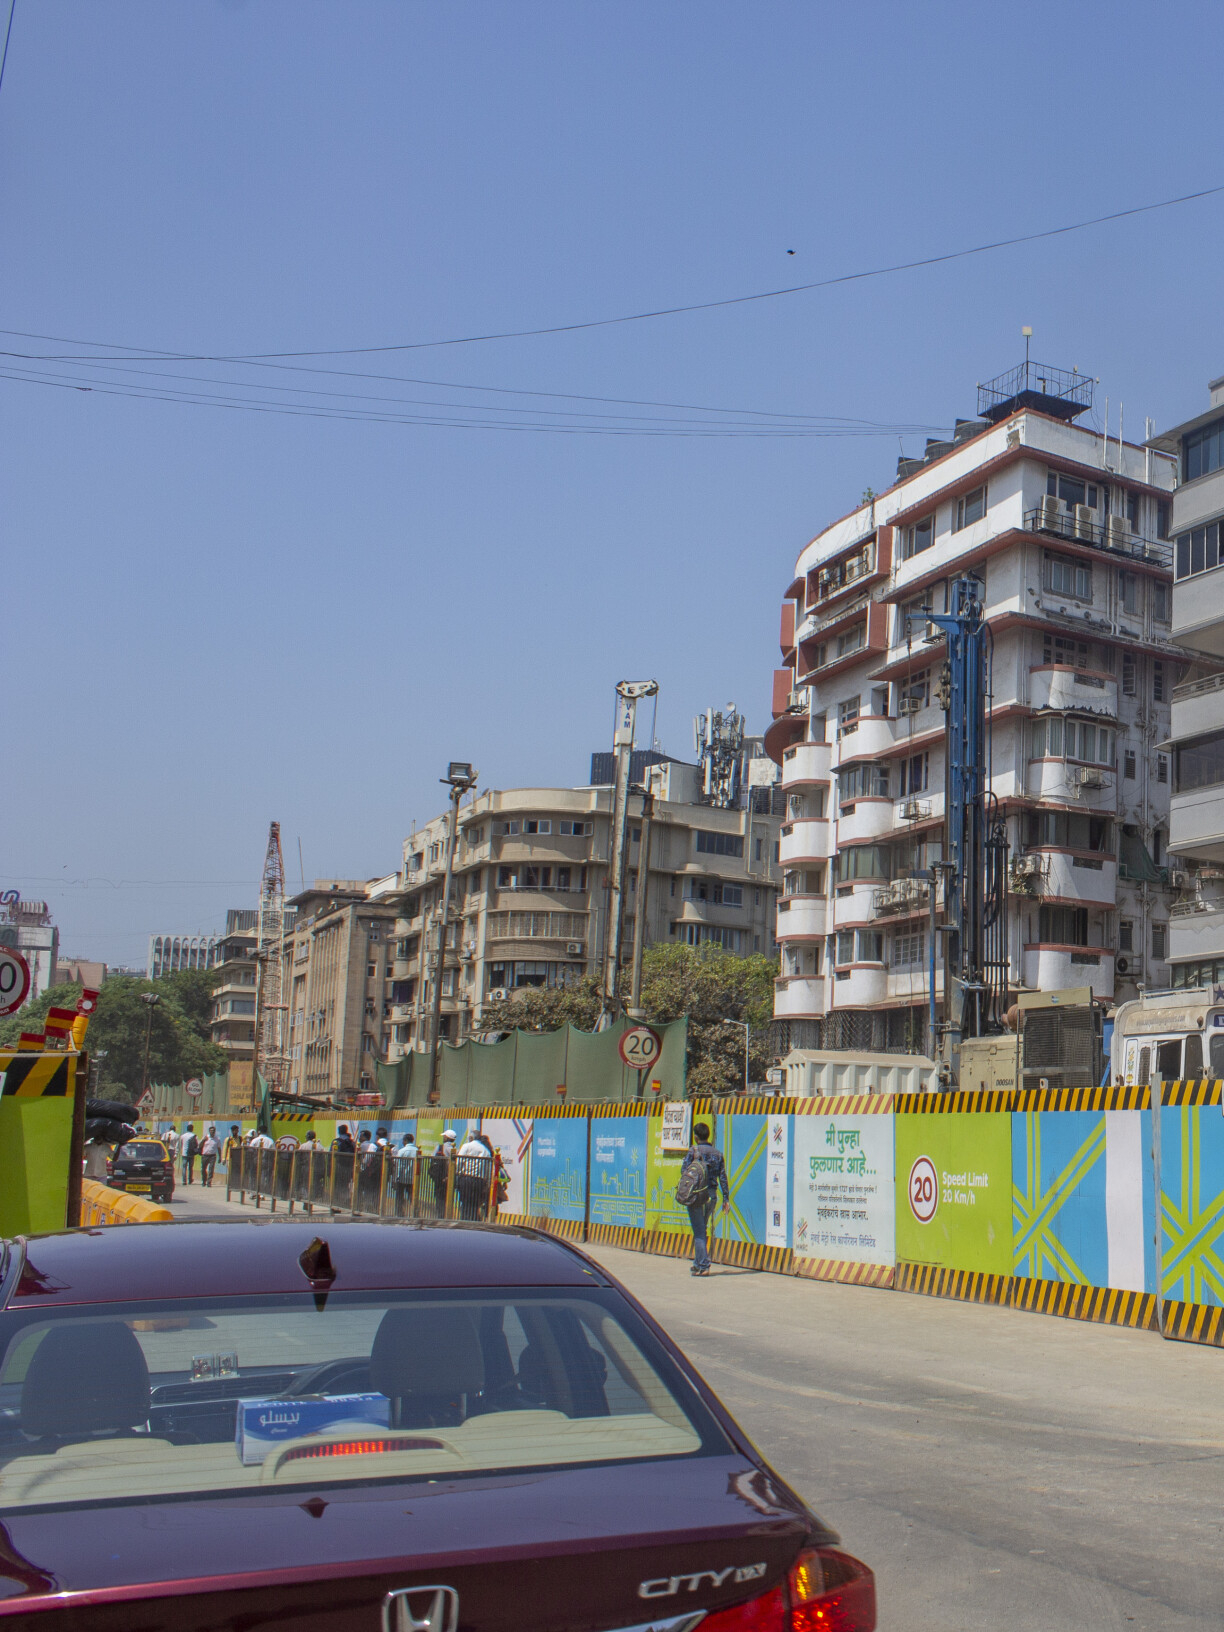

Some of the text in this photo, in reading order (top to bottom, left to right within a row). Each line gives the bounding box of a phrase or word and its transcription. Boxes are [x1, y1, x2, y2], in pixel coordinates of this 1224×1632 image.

[628, 1035, 654, 1056] 20
[826, 1123, 860, 1153] मी पुन्हा
[809, 1156, 844, 1179] फुलणार
[914, 1176, 933, 1203] 20
[942, 1171, 989, 1188] Speed Limit
[943, 1188, 976, 1206] 20 Km/h
[638, 1565, 735, 1598] CITY
